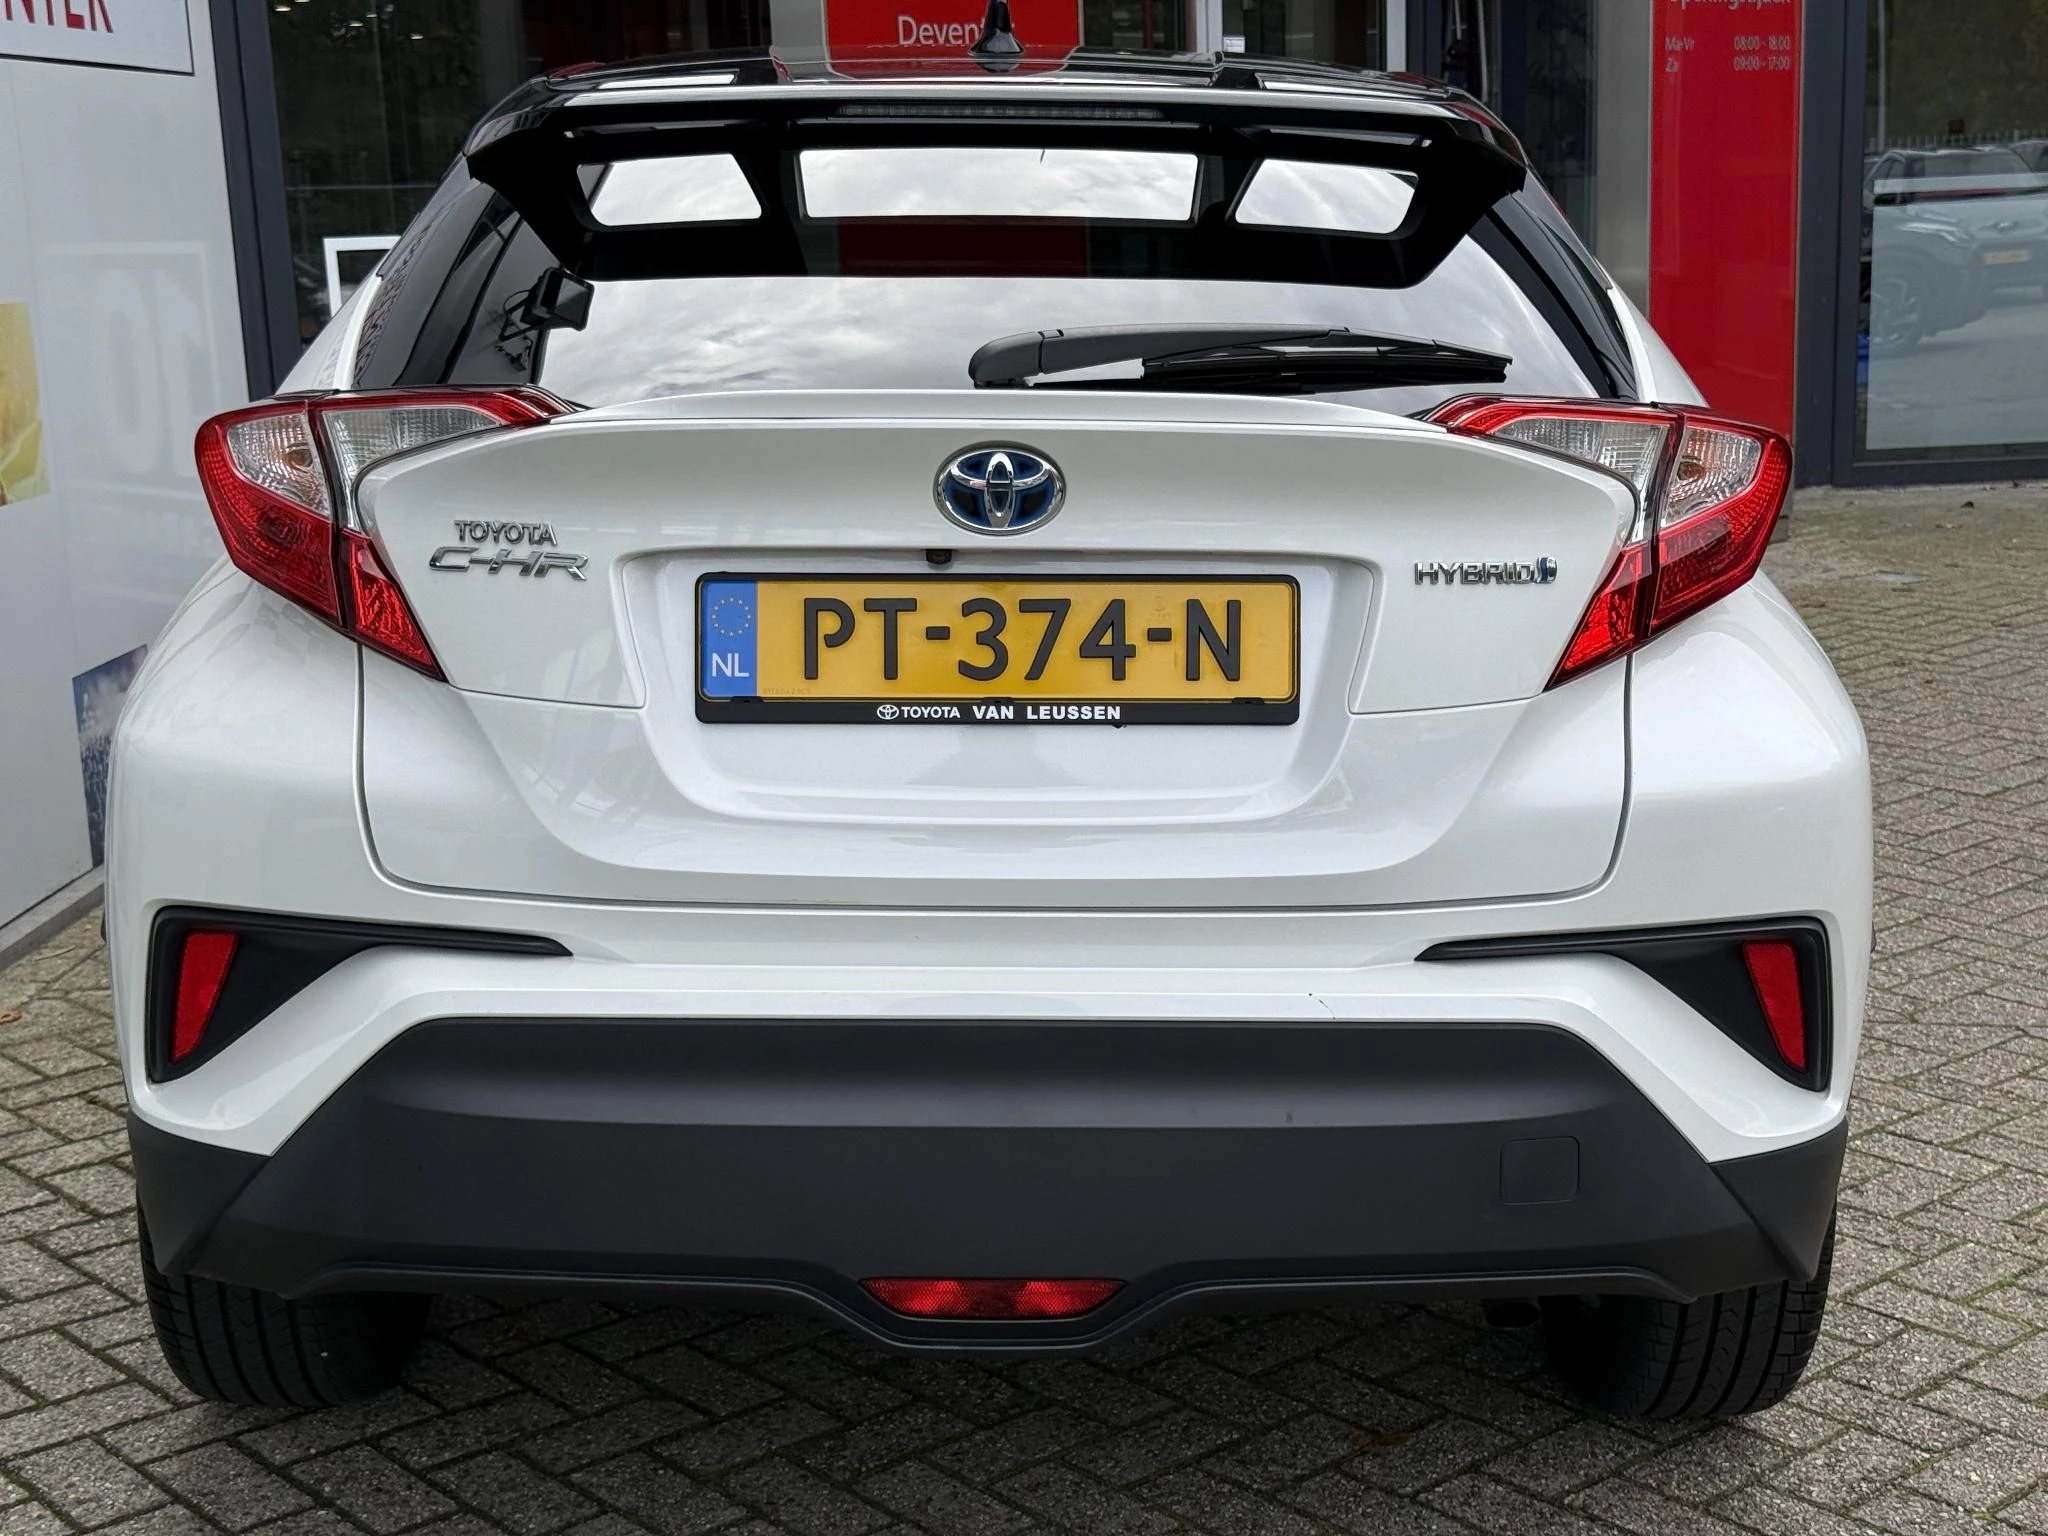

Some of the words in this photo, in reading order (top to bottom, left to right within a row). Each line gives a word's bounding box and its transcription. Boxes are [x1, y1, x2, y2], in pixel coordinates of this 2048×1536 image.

[898, 16, 1015, 45] Deven
[454, 520, 558, 547] TOYOTA
[429, 546, 589, 581] C-HR
[1414, 561, 1535, 586] HYBRID
[804, 598, 1242, 681] PT-374-N
[711, 653, 749, 677] NL
[901, 706, 961, 719] TOYOTA
[972, 705, 1014, 720] VAN
[1026, 705, 1121, 720] LEUSSEN
